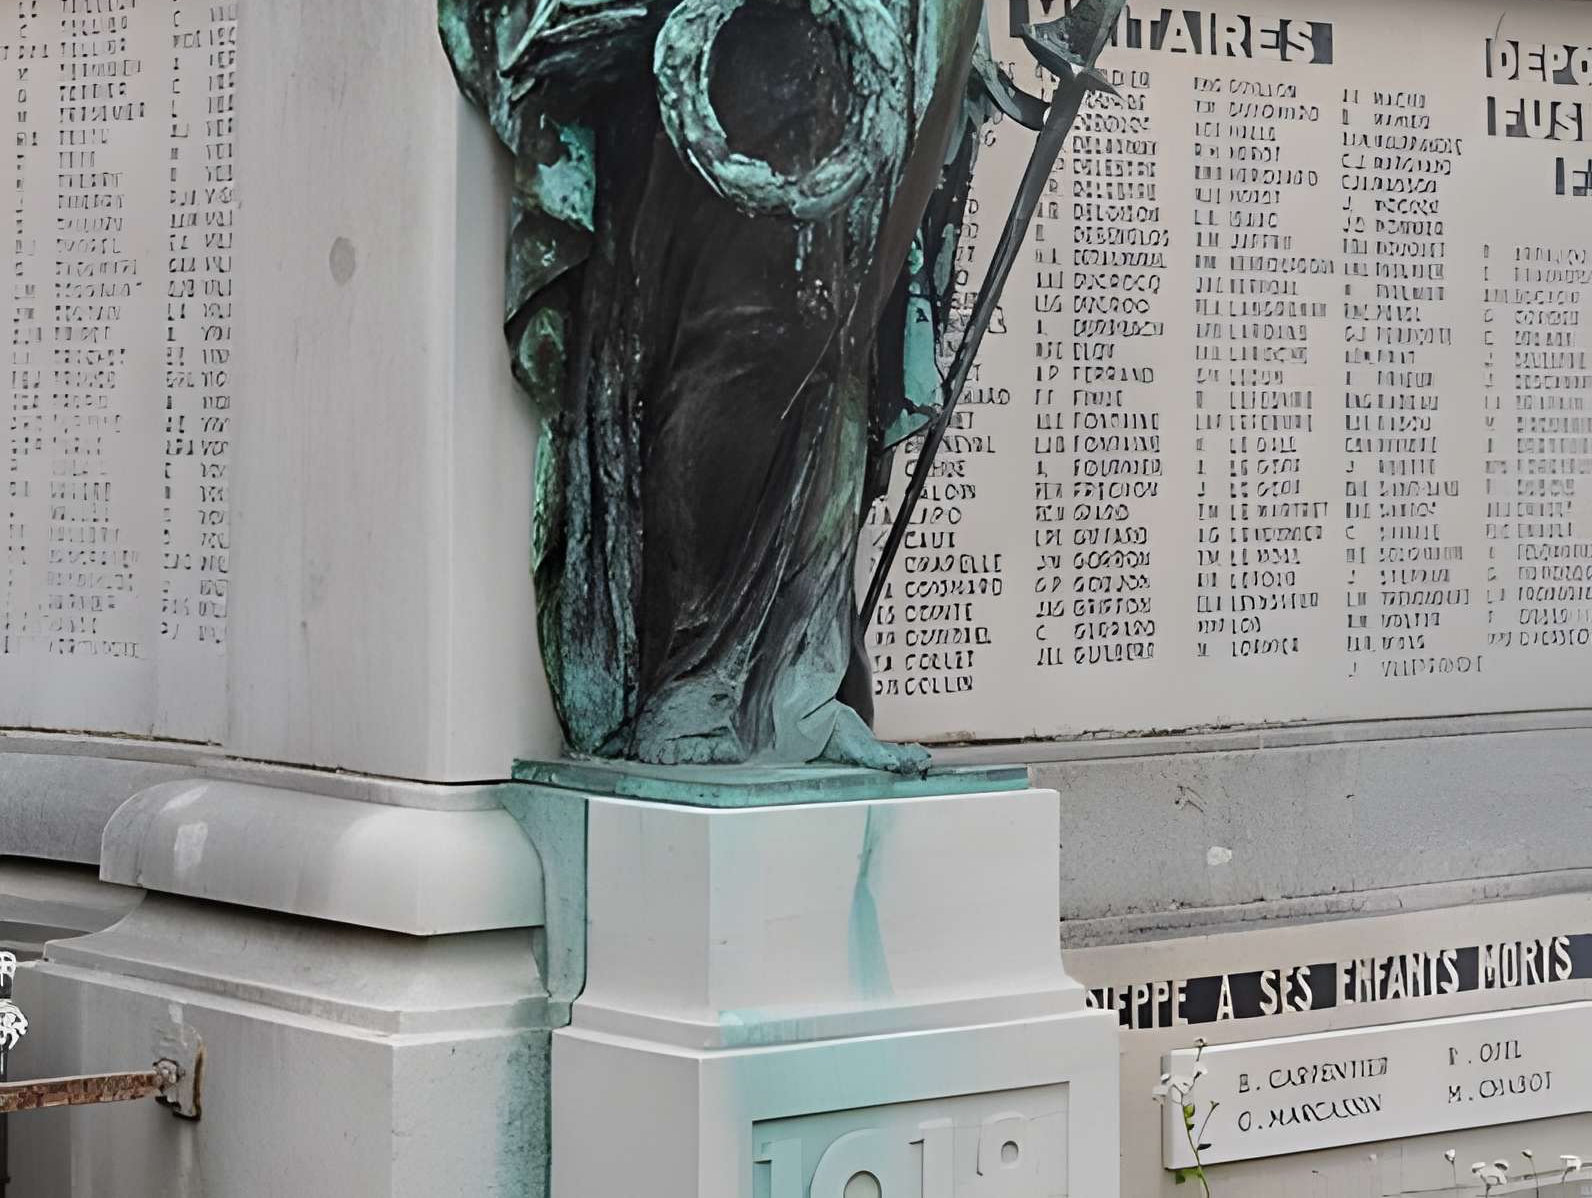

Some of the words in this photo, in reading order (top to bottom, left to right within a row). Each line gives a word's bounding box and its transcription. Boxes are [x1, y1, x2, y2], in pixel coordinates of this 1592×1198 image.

[1216, 973, 1235, 1021] A
[1259, 965, 1313, 1016] SES
[1336, 948, 1460, 1003] ENFANTS
[1478, 935, 1573, 990] MORTS
